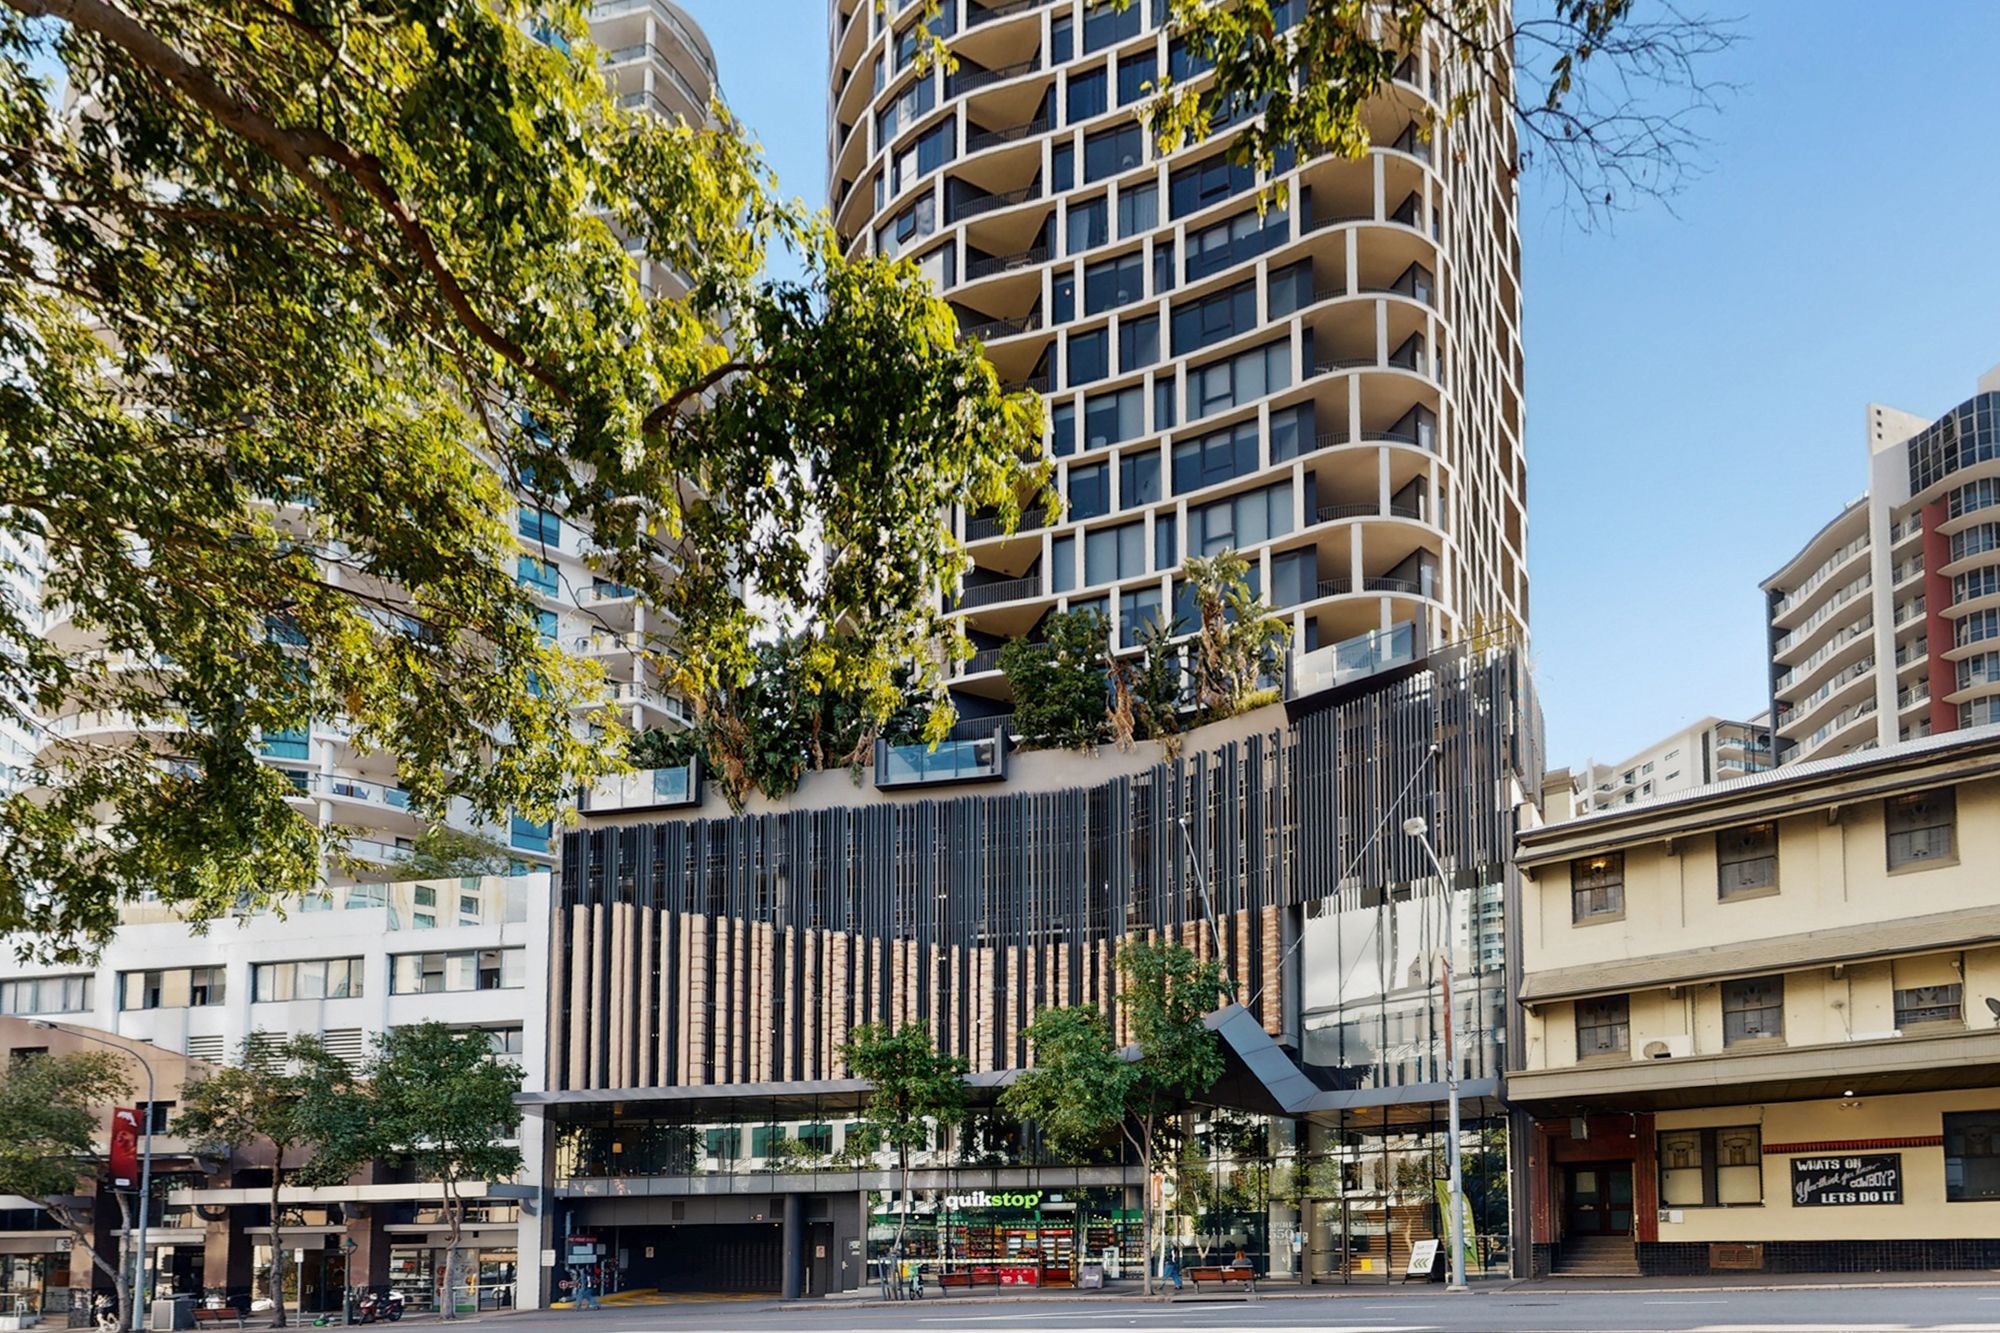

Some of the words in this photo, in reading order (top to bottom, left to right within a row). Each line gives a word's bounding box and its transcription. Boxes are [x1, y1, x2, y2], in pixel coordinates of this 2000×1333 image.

[1796, 1160, 1840, 1171] WHATS
[1844, 1159, 1862, 1169] ON
[1821, 1192, 1856, 1203] LETS
[1859, 1192, 1879, 1202] DO
[1882, 1191, 1896, 1202] IT
